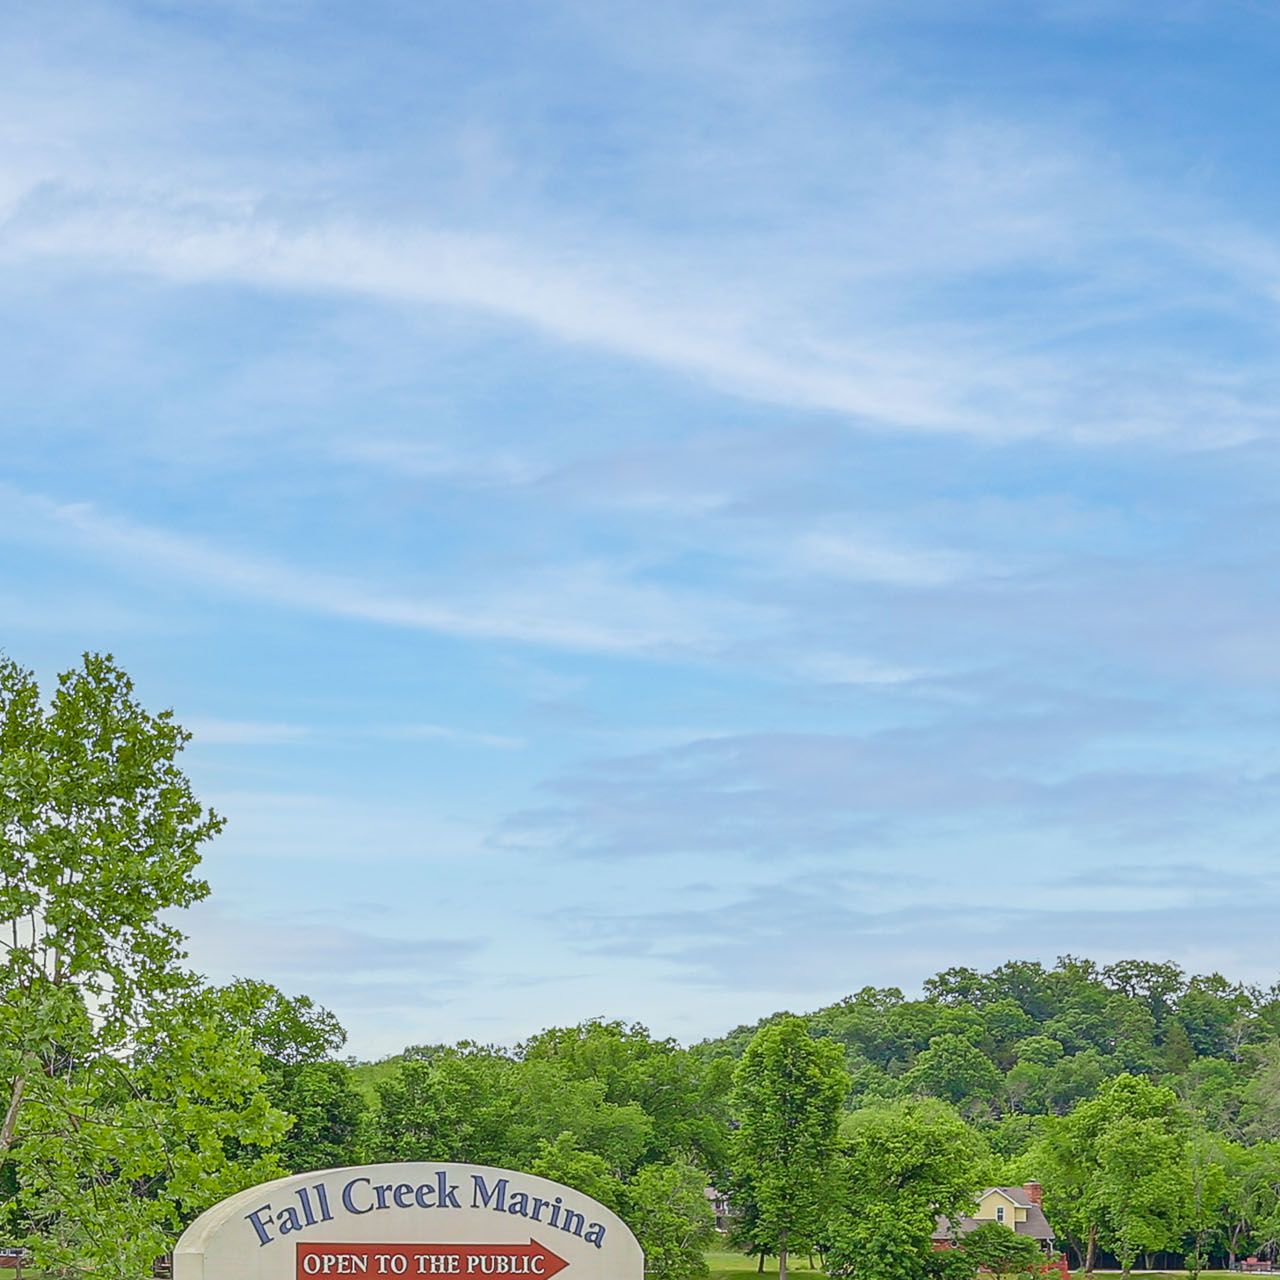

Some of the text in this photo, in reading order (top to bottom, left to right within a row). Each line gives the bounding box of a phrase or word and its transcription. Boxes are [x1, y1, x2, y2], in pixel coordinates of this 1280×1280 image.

[244, 1171, 607, 1249] Fall Creek Marina
[303, 1253, 545, 1275] OPEN TO THE PUBLIC
